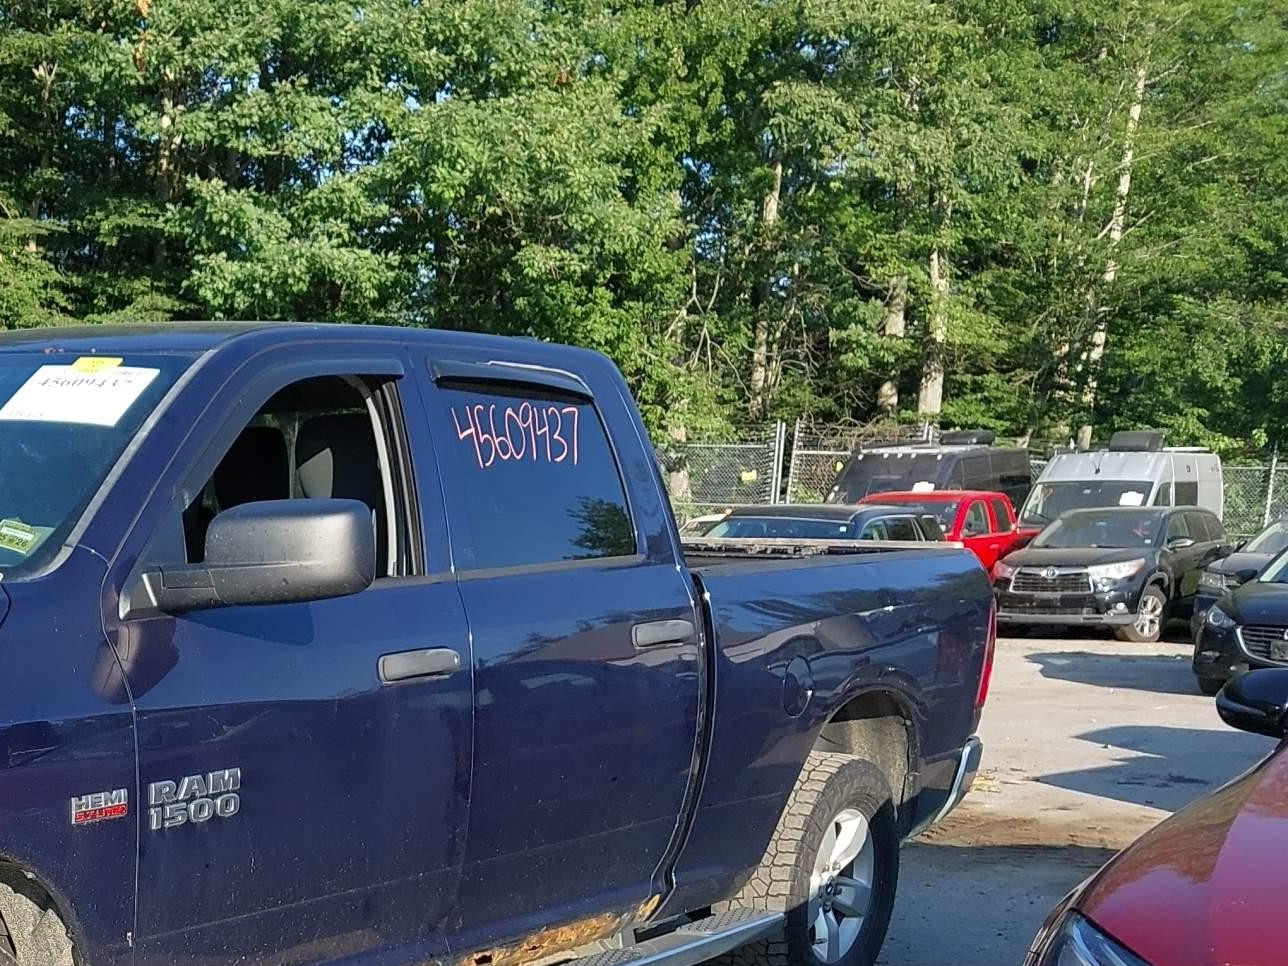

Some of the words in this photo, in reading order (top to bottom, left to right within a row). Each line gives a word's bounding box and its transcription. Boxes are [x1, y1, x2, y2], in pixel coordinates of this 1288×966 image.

[451, 401, 579, 469] 45609437
[71, 788, 128, 811] HEMI
[149, 767, 241, 805] RAM
[75, 811, 95, 821] 5.7
[149, 793, 241, 830] 1500
